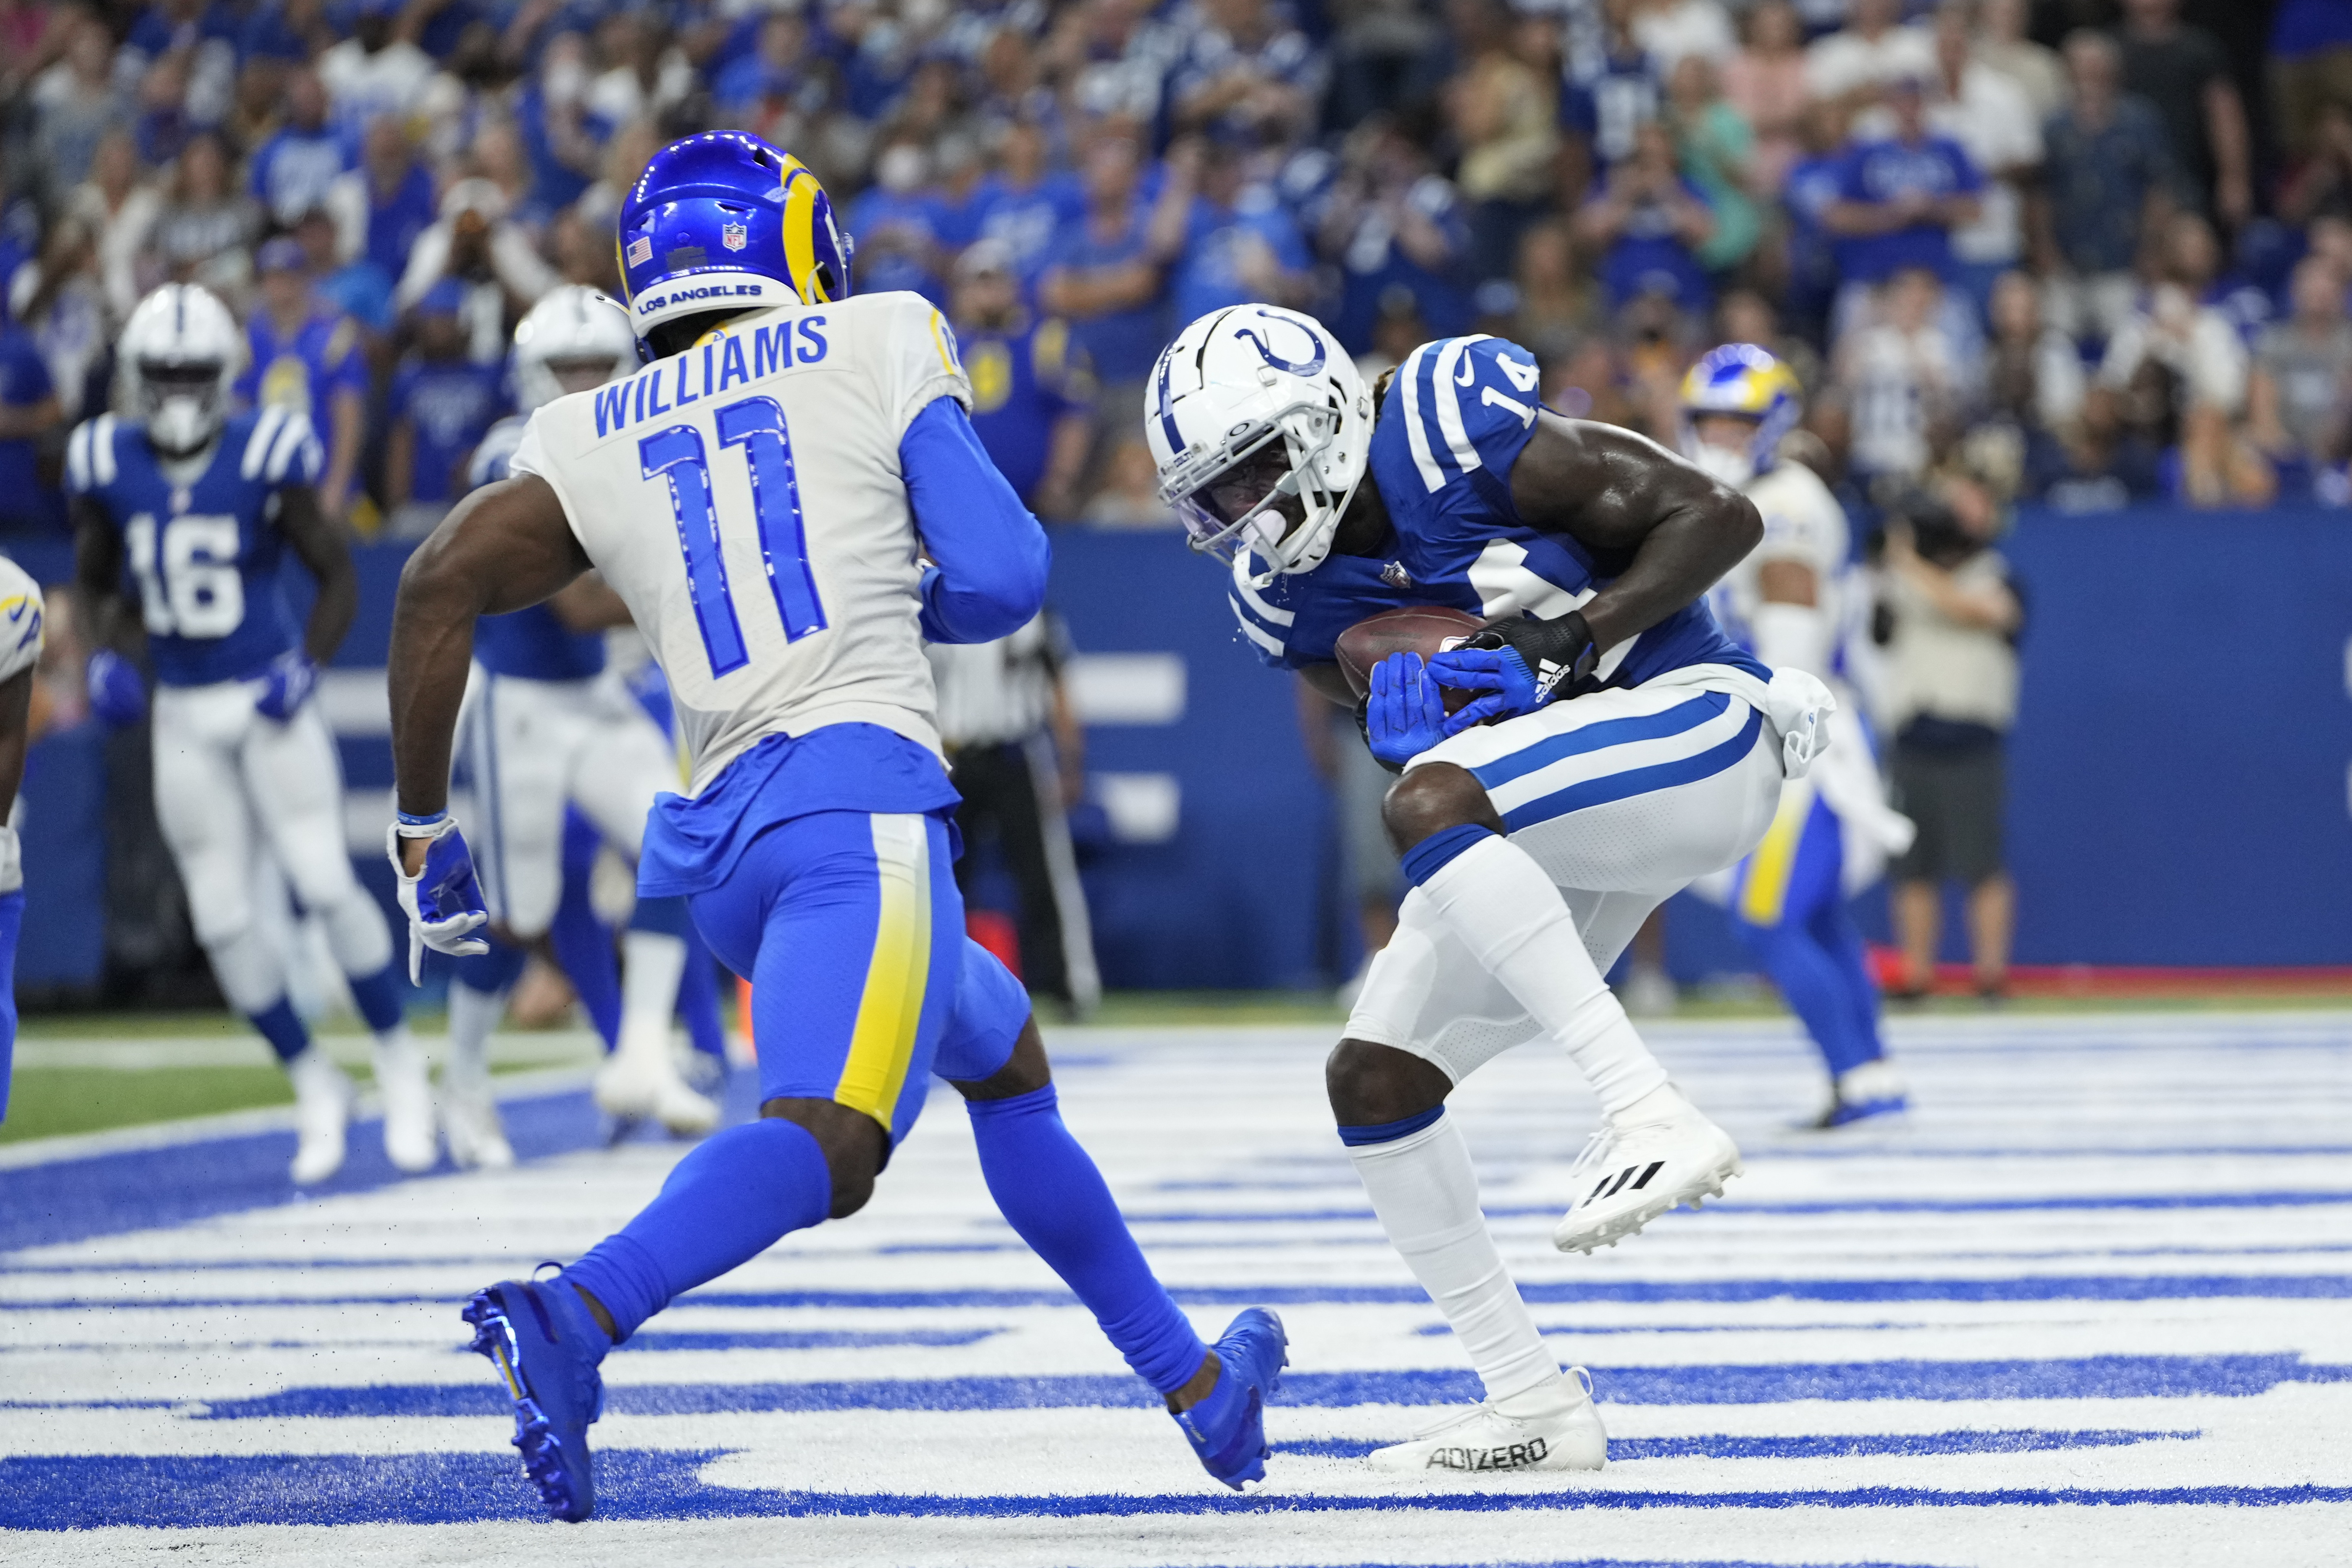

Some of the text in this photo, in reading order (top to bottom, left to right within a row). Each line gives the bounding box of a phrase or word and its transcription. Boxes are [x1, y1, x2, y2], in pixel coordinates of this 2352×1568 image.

[726, 234, 744, 247] NFL
[638, 285, 762, 315] LOS ANGELES
[594, 315, 828, 438] WILLIAMS
[1481, 352, 1540, 430] 14
[638, 395, 828, 680] 11
[126, 512, 245, 639] 16
[1535, 664, 1571, 703] adidas
[1426, 1437, 1548, 1470] ADIZERO
